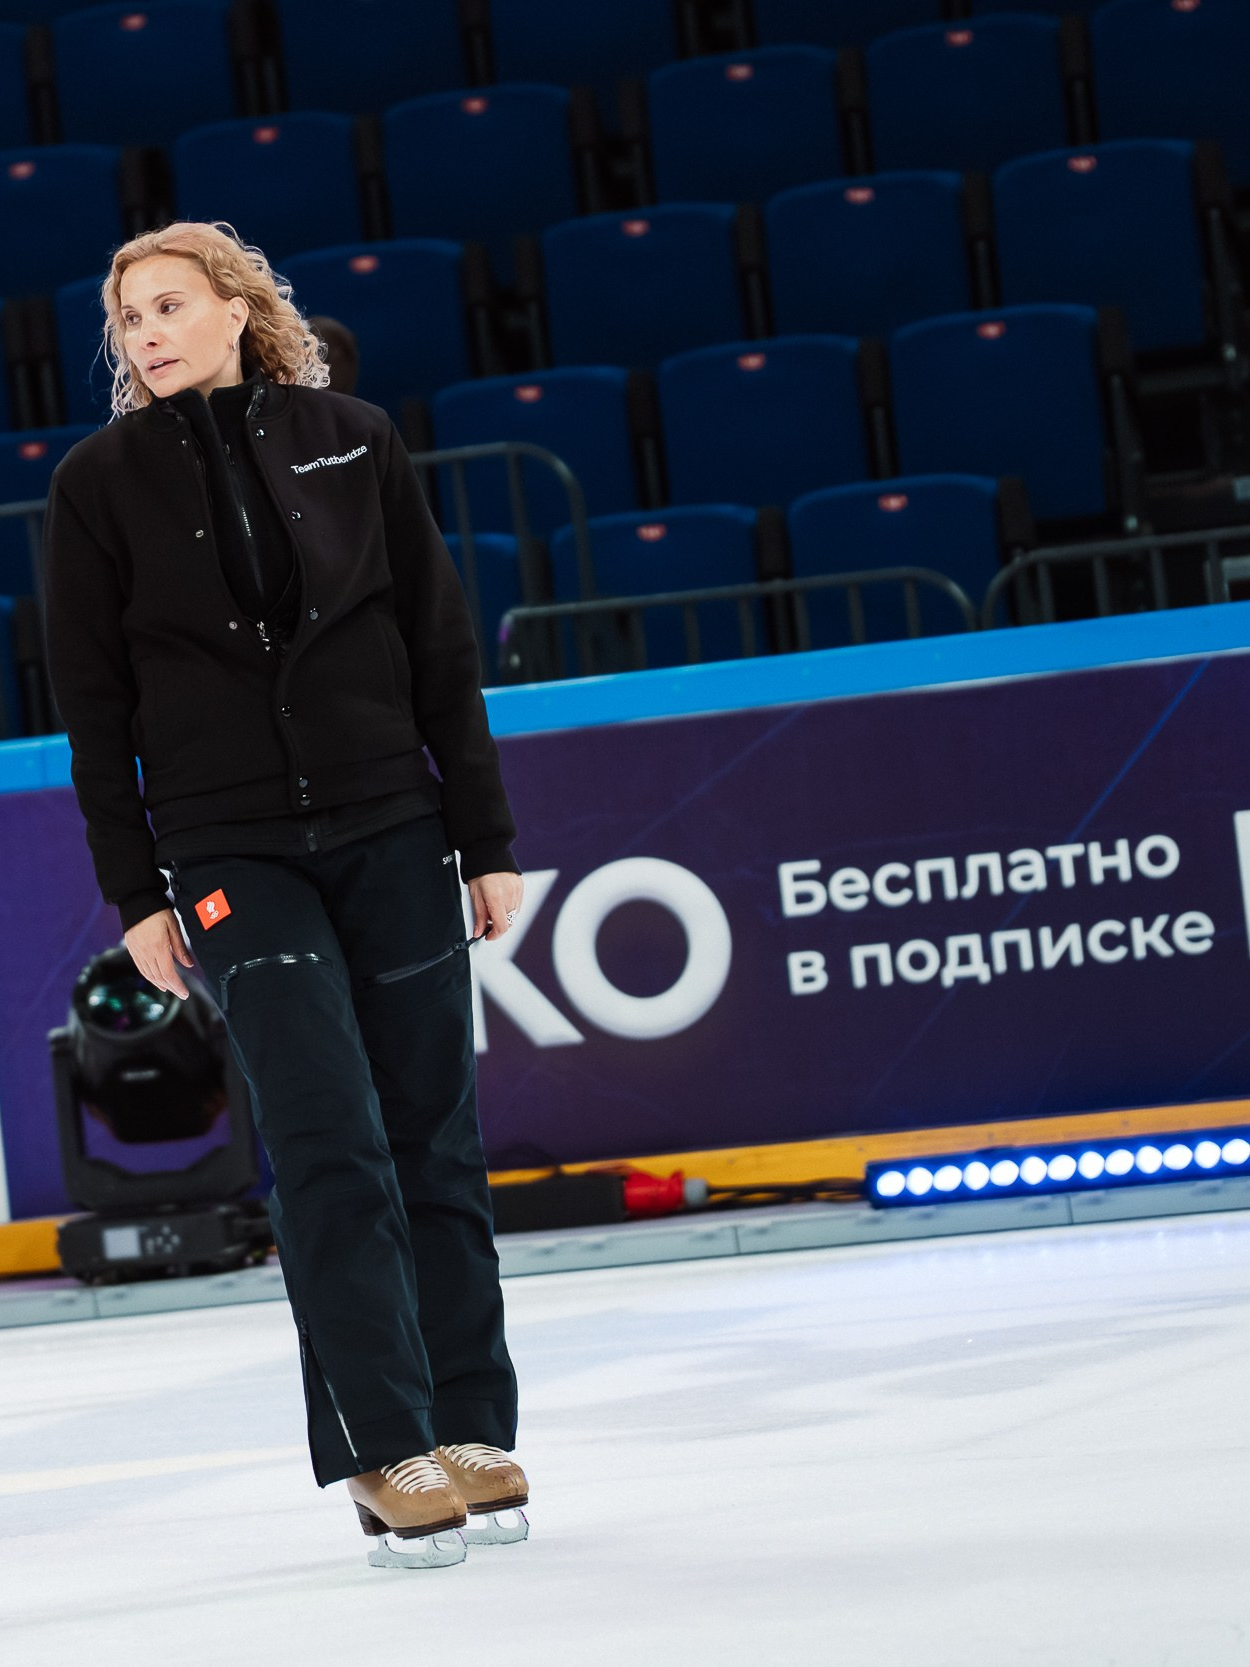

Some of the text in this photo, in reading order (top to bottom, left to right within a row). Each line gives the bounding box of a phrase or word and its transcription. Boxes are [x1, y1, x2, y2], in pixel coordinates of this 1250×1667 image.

[778, 834, 1181, 918] Бесплатно
[455, 851, 733, 1054] КО
[787, 910, 1216, 995] в подписке
